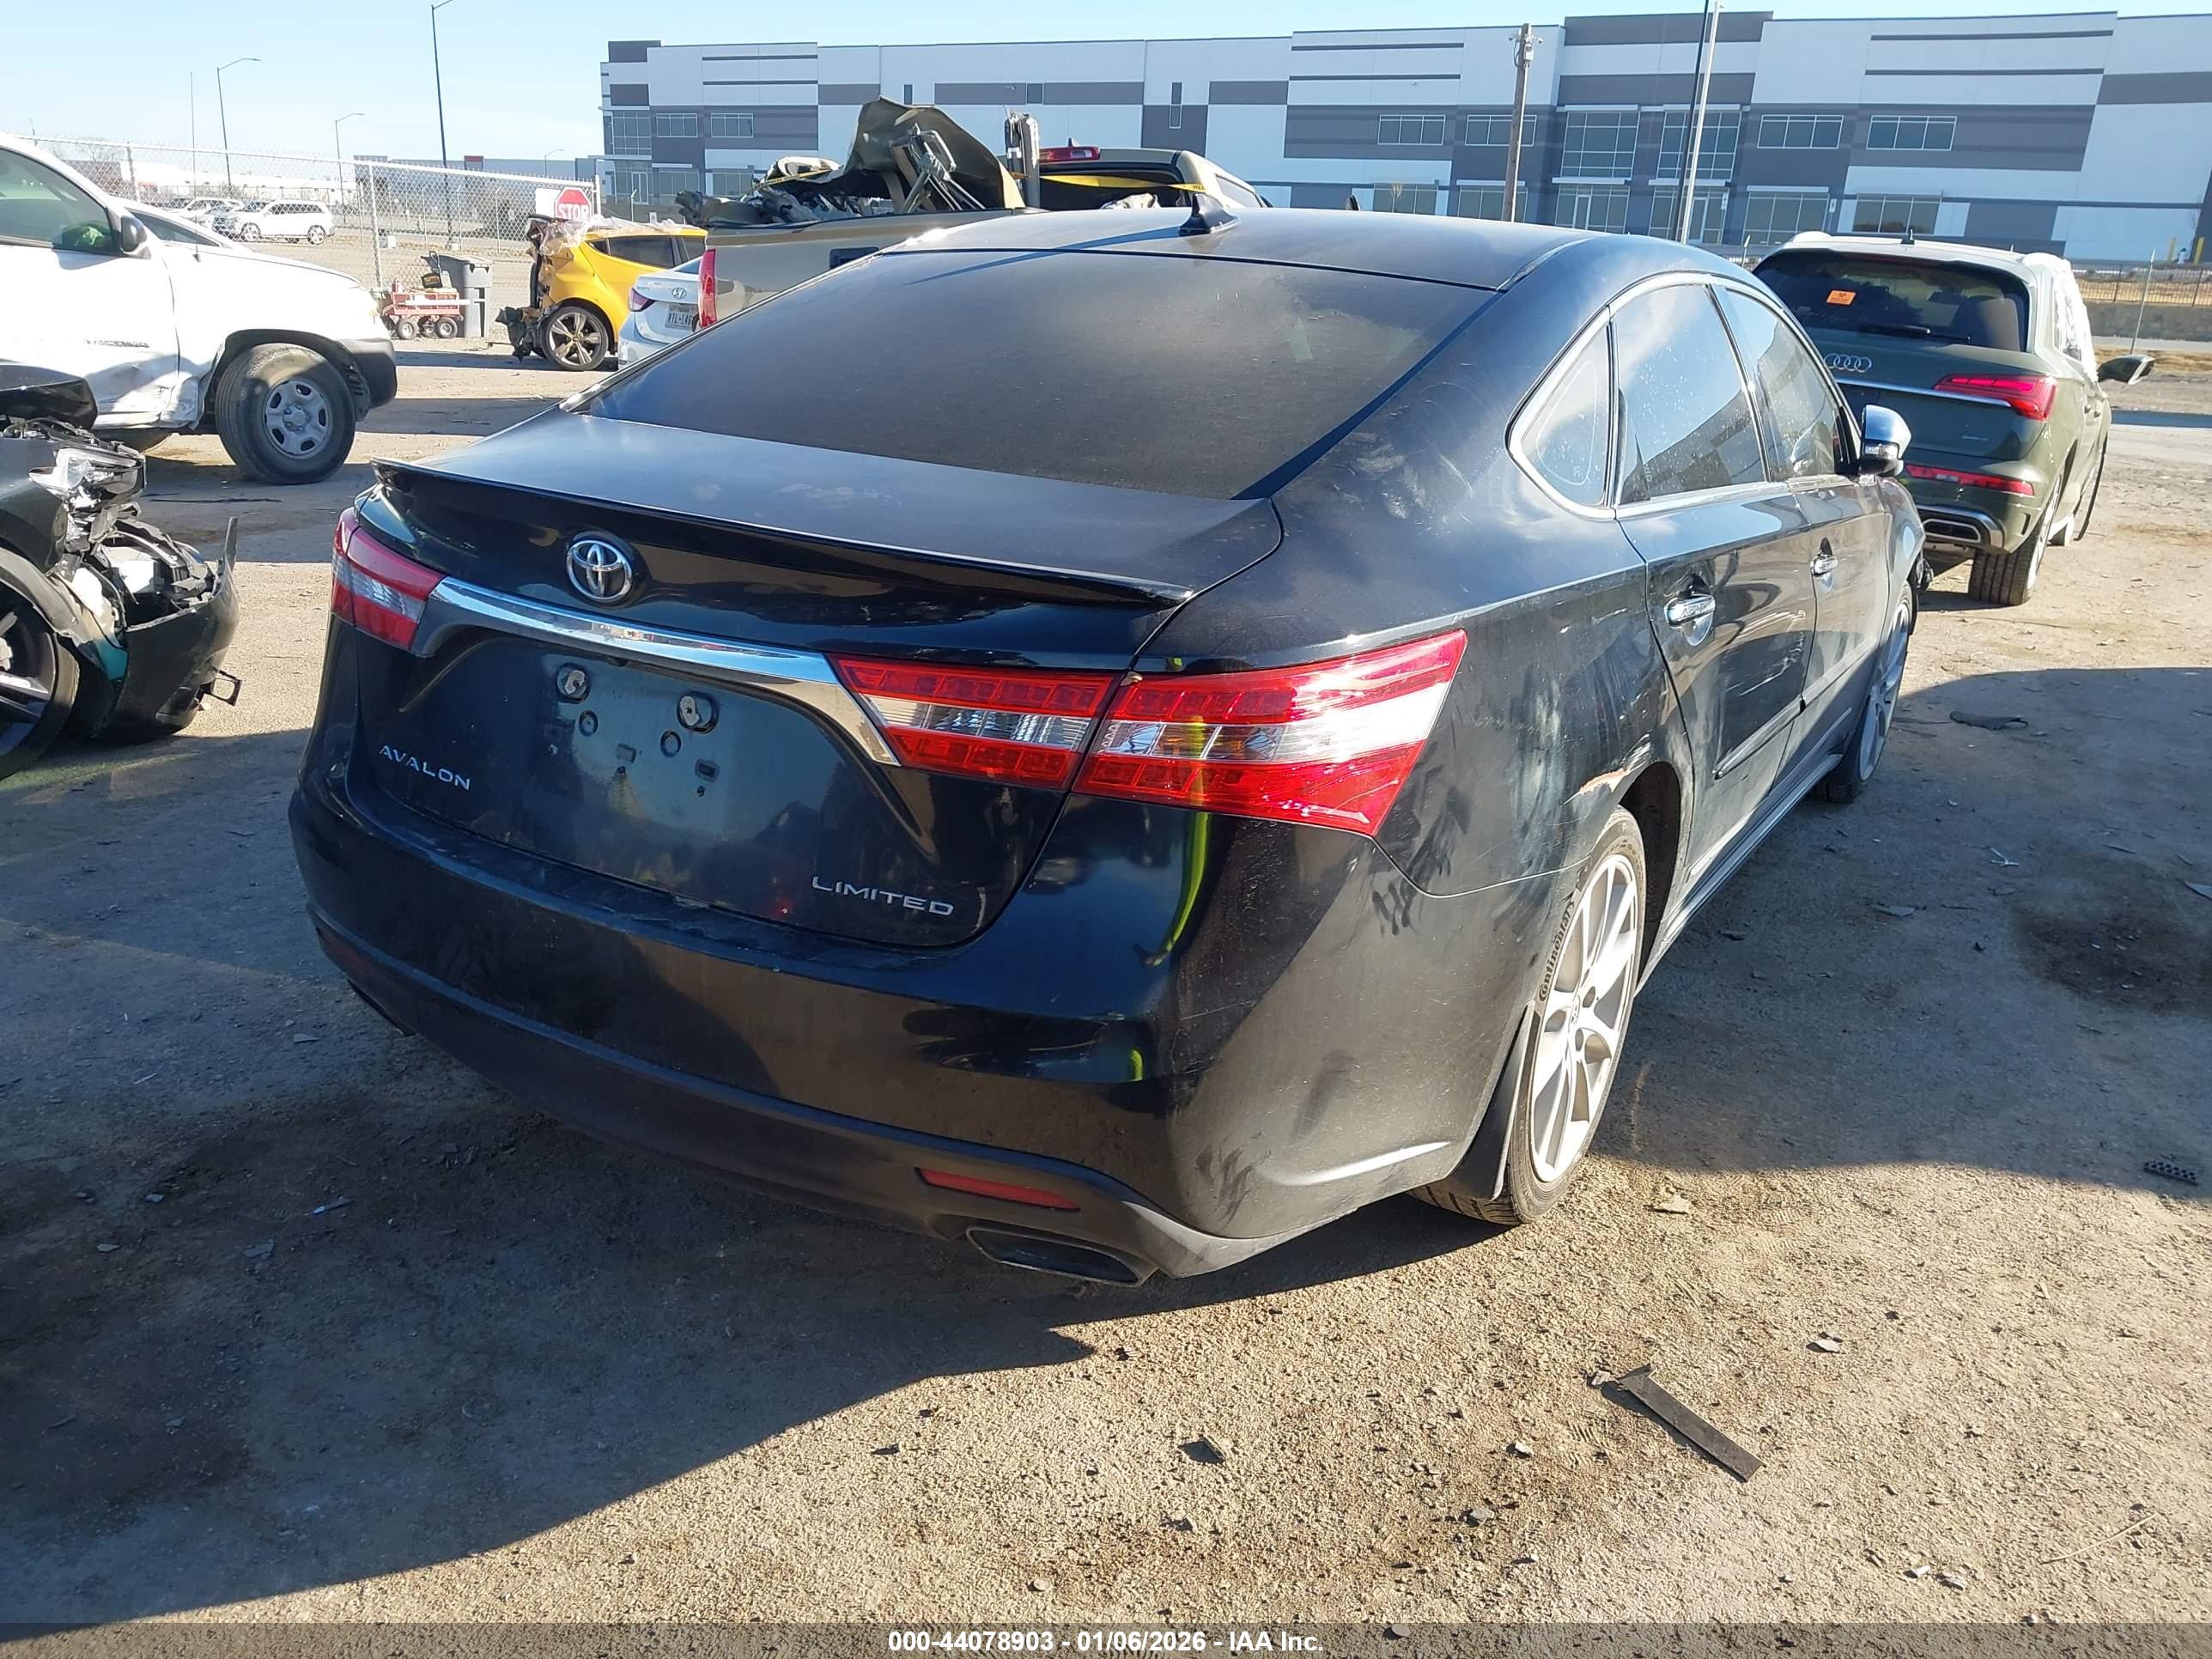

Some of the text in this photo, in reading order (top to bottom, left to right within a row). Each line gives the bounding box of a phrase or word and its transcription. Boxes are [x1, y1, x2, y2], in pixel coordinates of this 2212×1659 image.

[558, 203, 589, 221] STOP
[379, 744, 471, 790] AVALON
[812, 876, 954, 915] LIMITED
